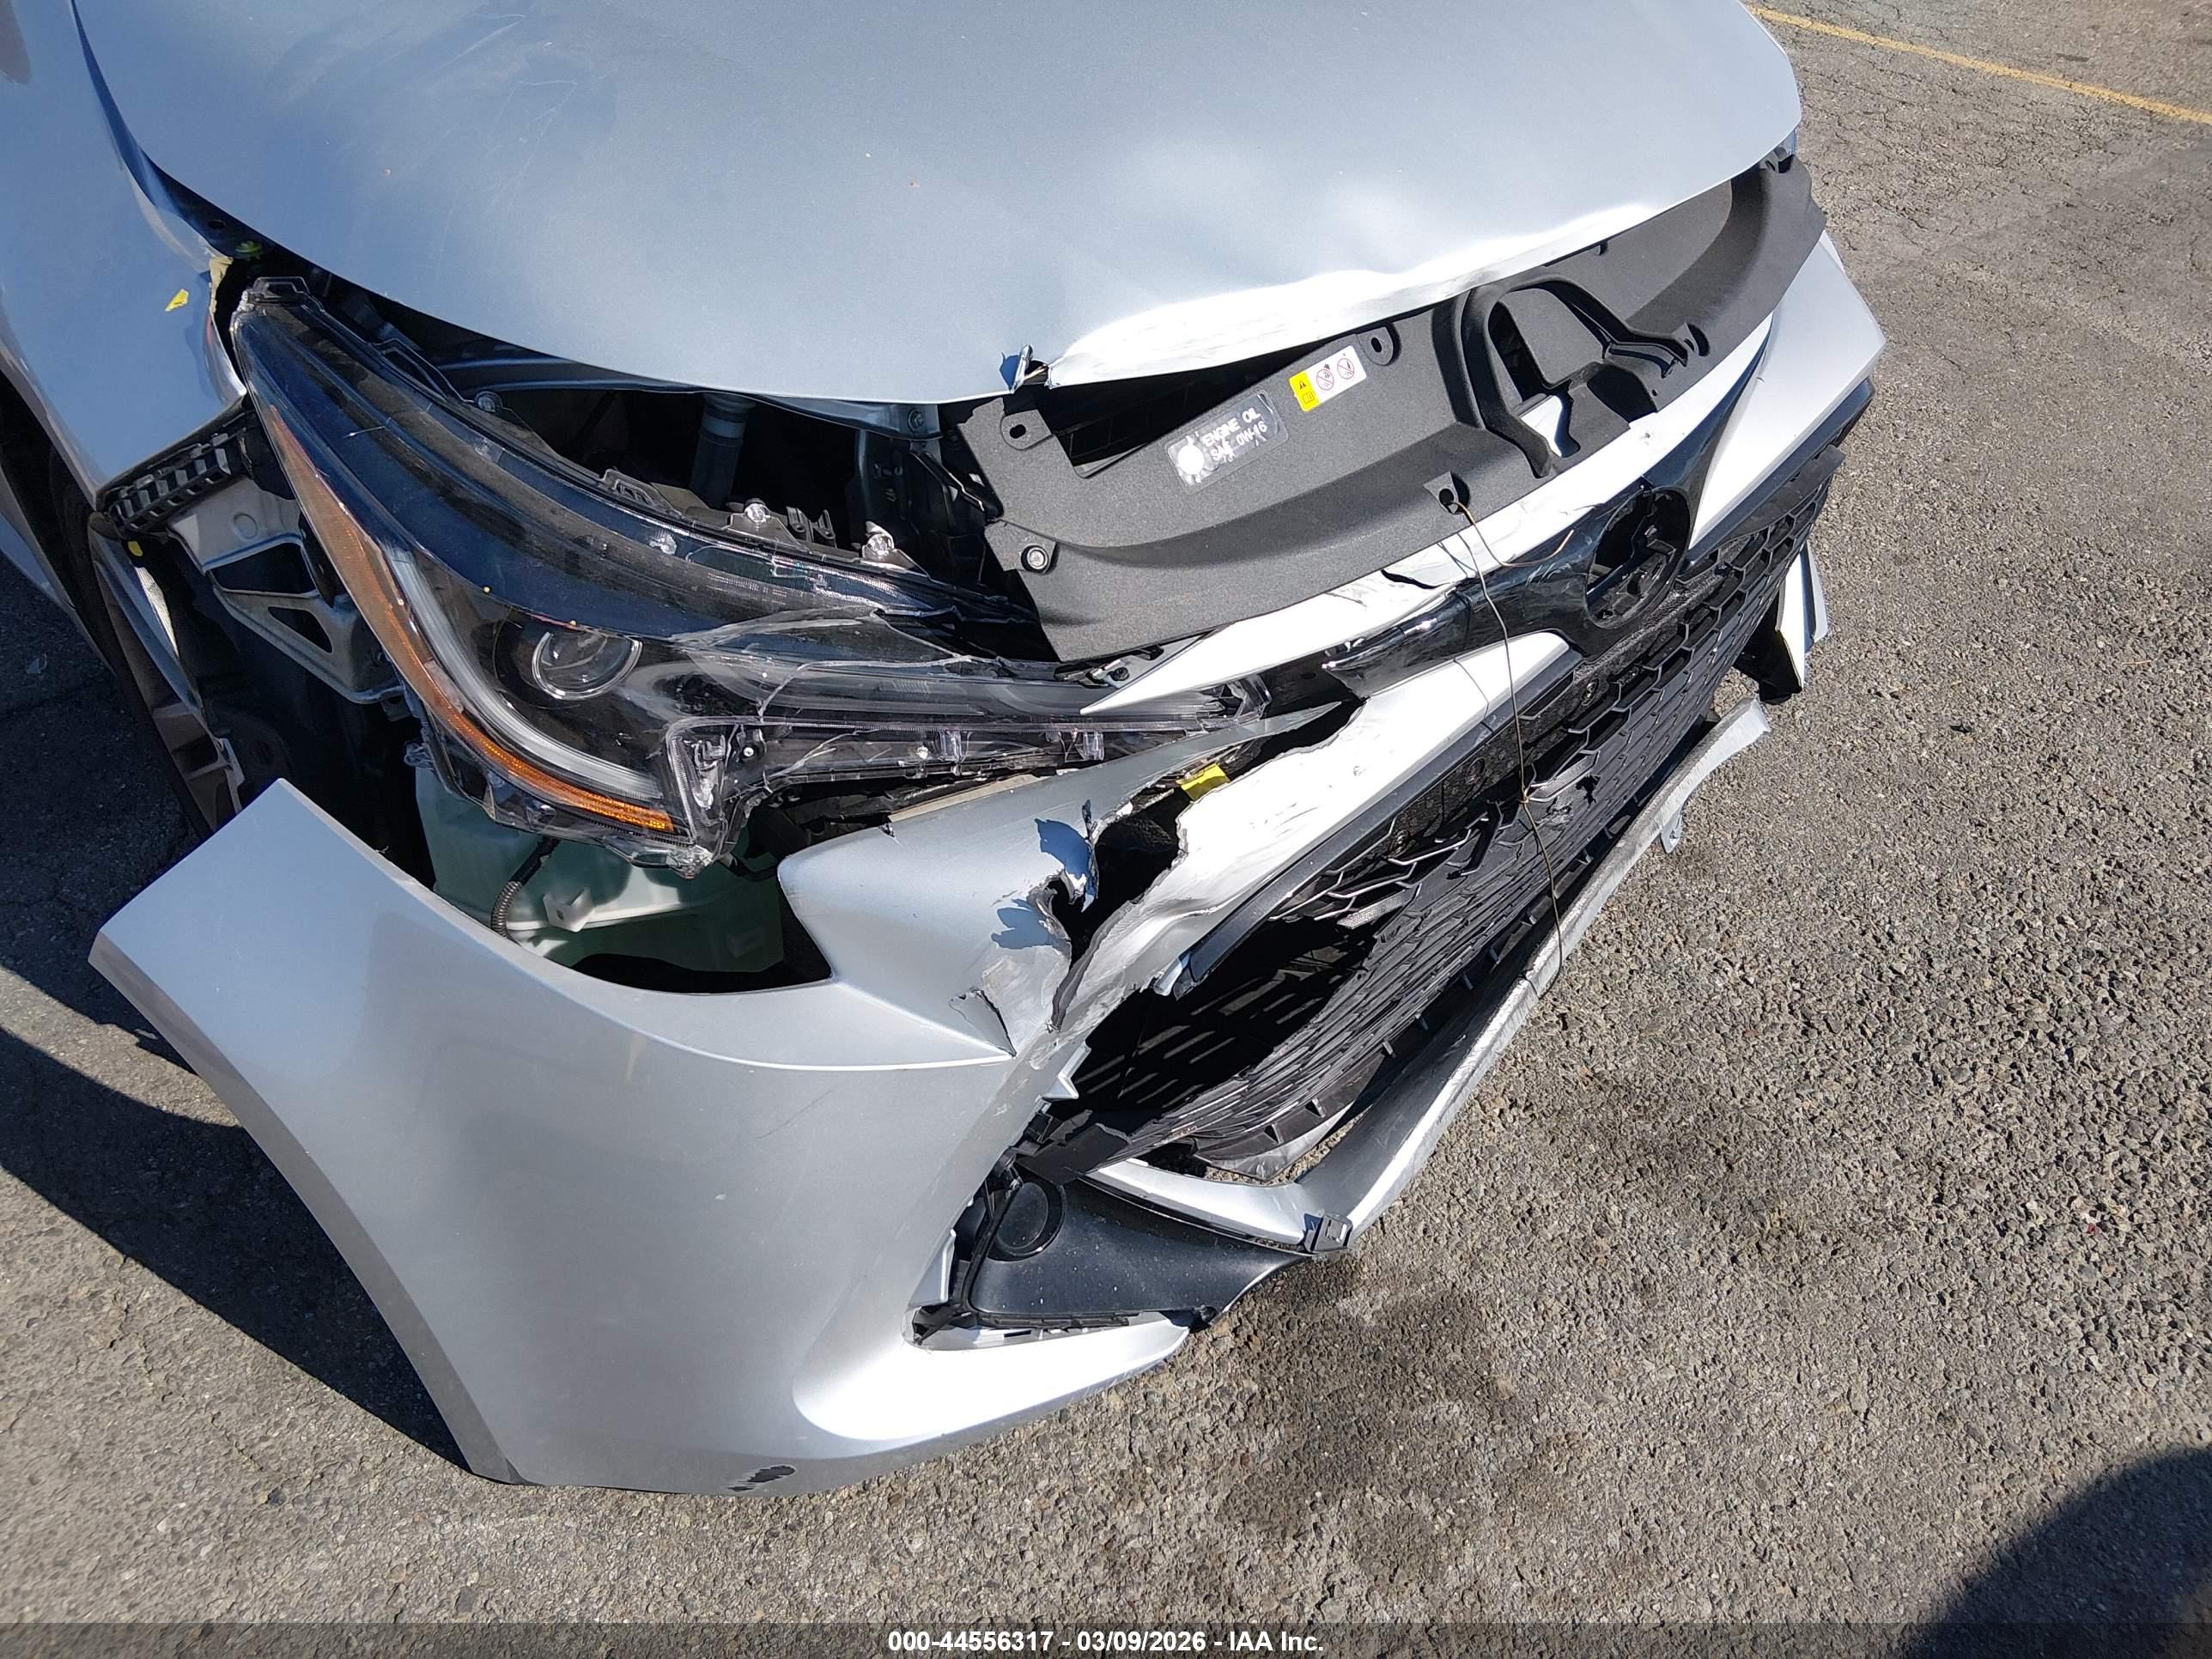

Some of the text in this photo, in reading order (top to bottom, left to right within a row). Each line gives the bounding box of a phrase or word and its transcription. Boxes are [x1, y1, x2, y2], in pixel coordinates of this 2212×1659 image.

[1202, 407, 1261, 447] ENGINE OIL
[1236, 421, 1267, 446] 0W-16
